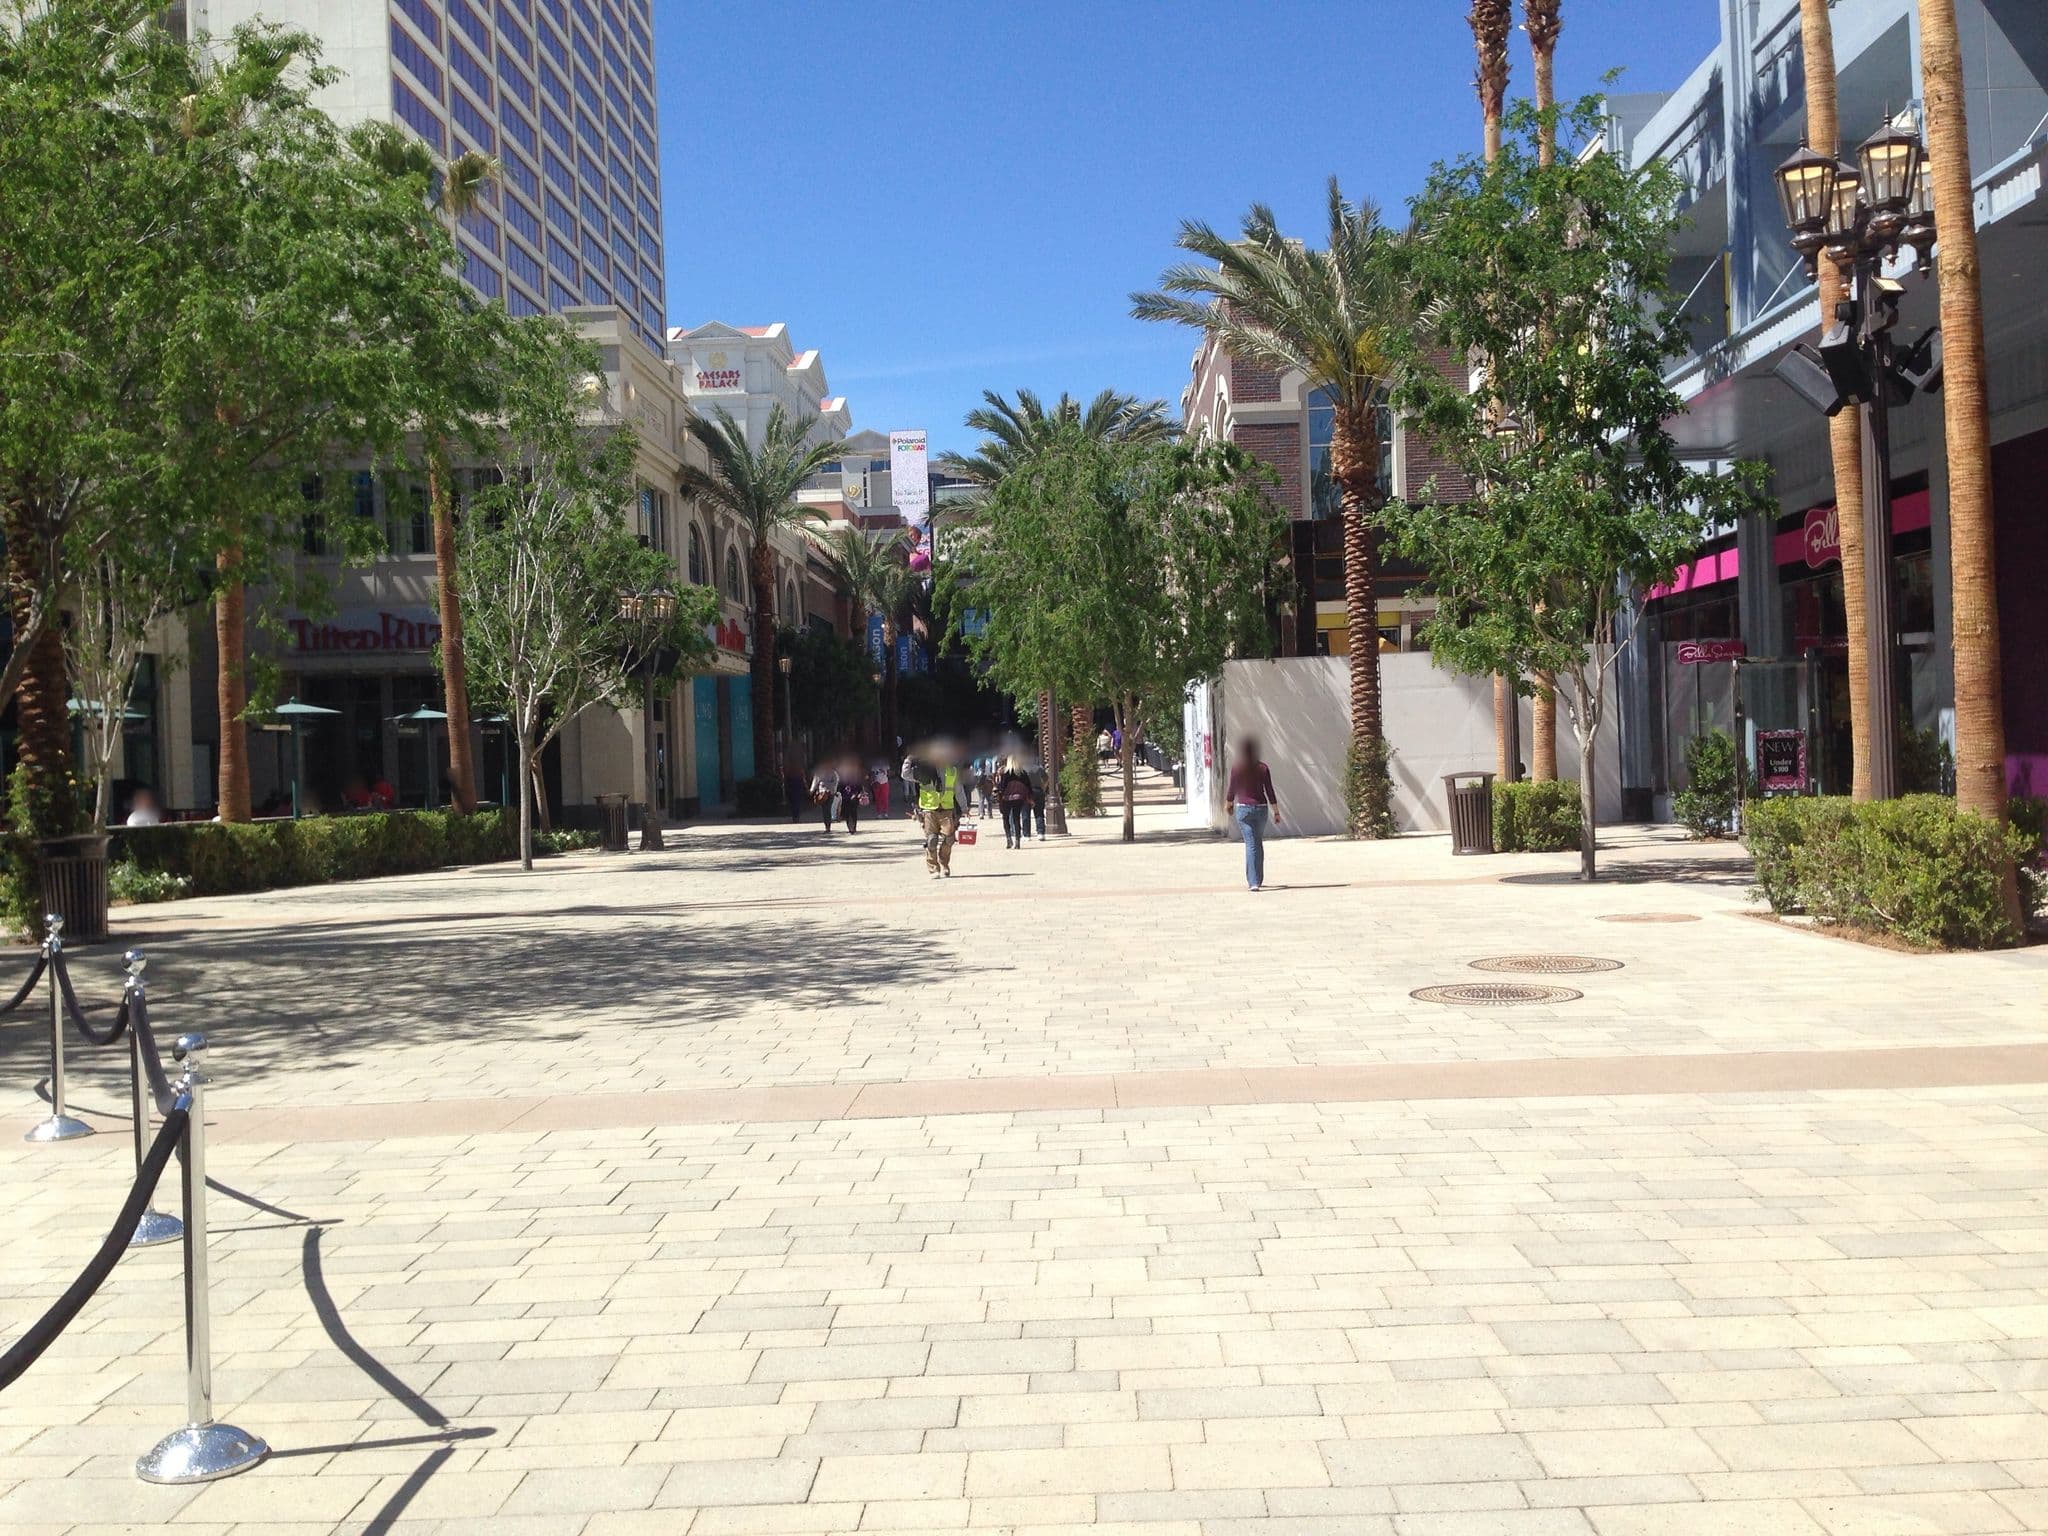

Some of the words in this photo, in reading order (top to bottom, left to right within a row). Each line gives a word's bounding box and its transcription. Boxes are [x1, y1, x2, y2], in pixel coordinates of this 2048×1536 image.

[696, 370, 741, 380] CAESARS
[698, 379, 738, 389] PALACE
[1765, 742, 1794, 752] NEW
[1769, 758, 1792, 766] Under
